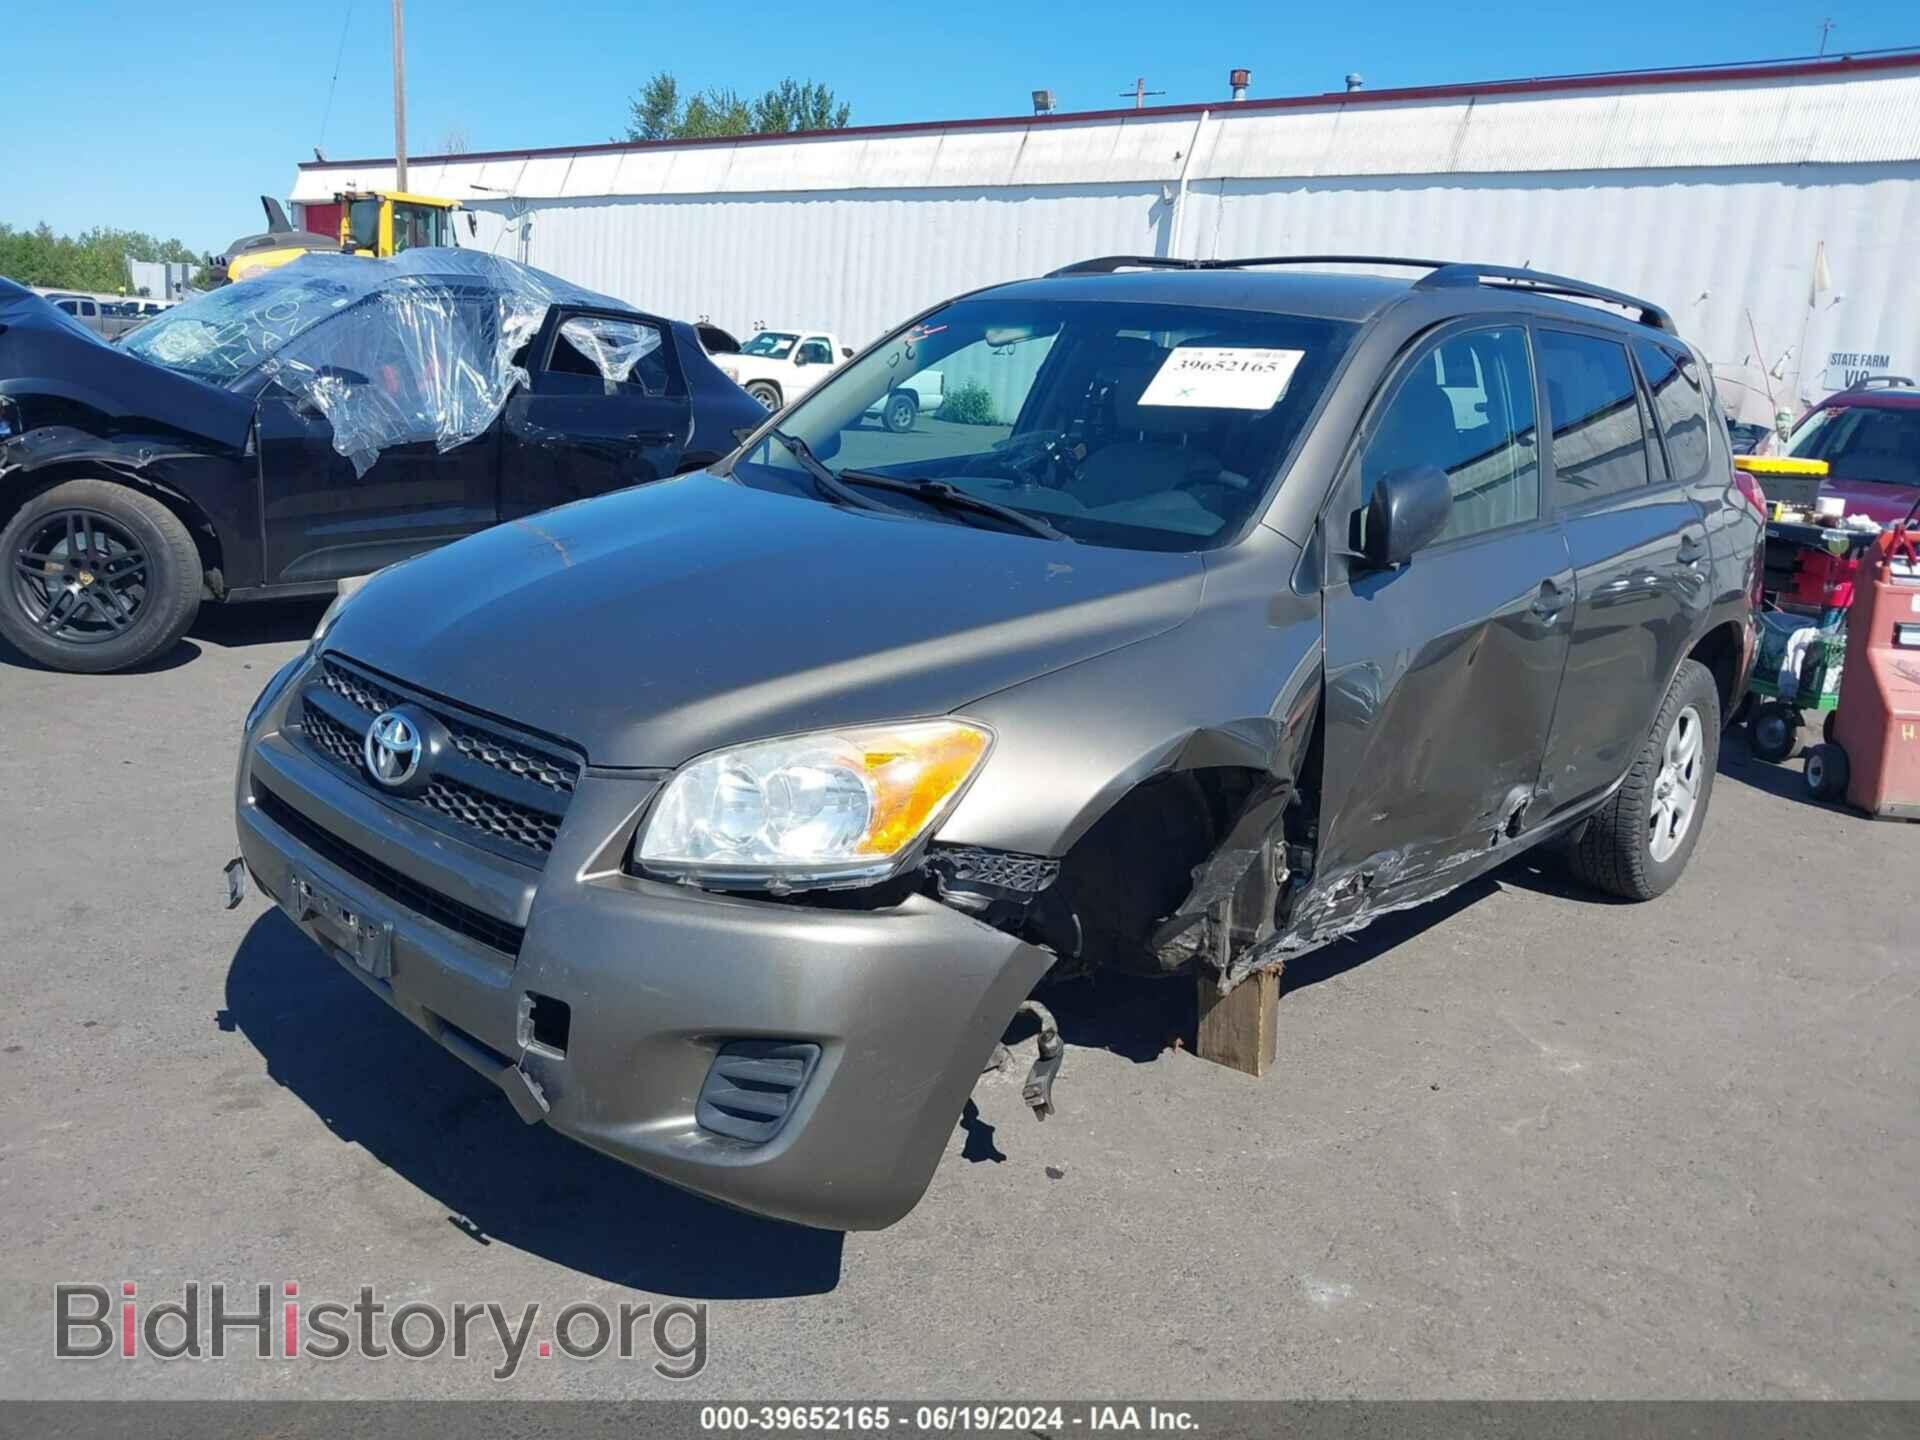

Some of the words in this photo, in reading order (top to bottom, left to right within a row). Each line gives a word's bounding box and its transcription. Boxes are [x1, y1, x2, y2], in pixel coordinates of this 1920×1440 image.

[1173, 359, 1279, 374] 39652165
[1830, 352, 1858, 367] STATE
[1860, 354, 1890, 368] FARM
